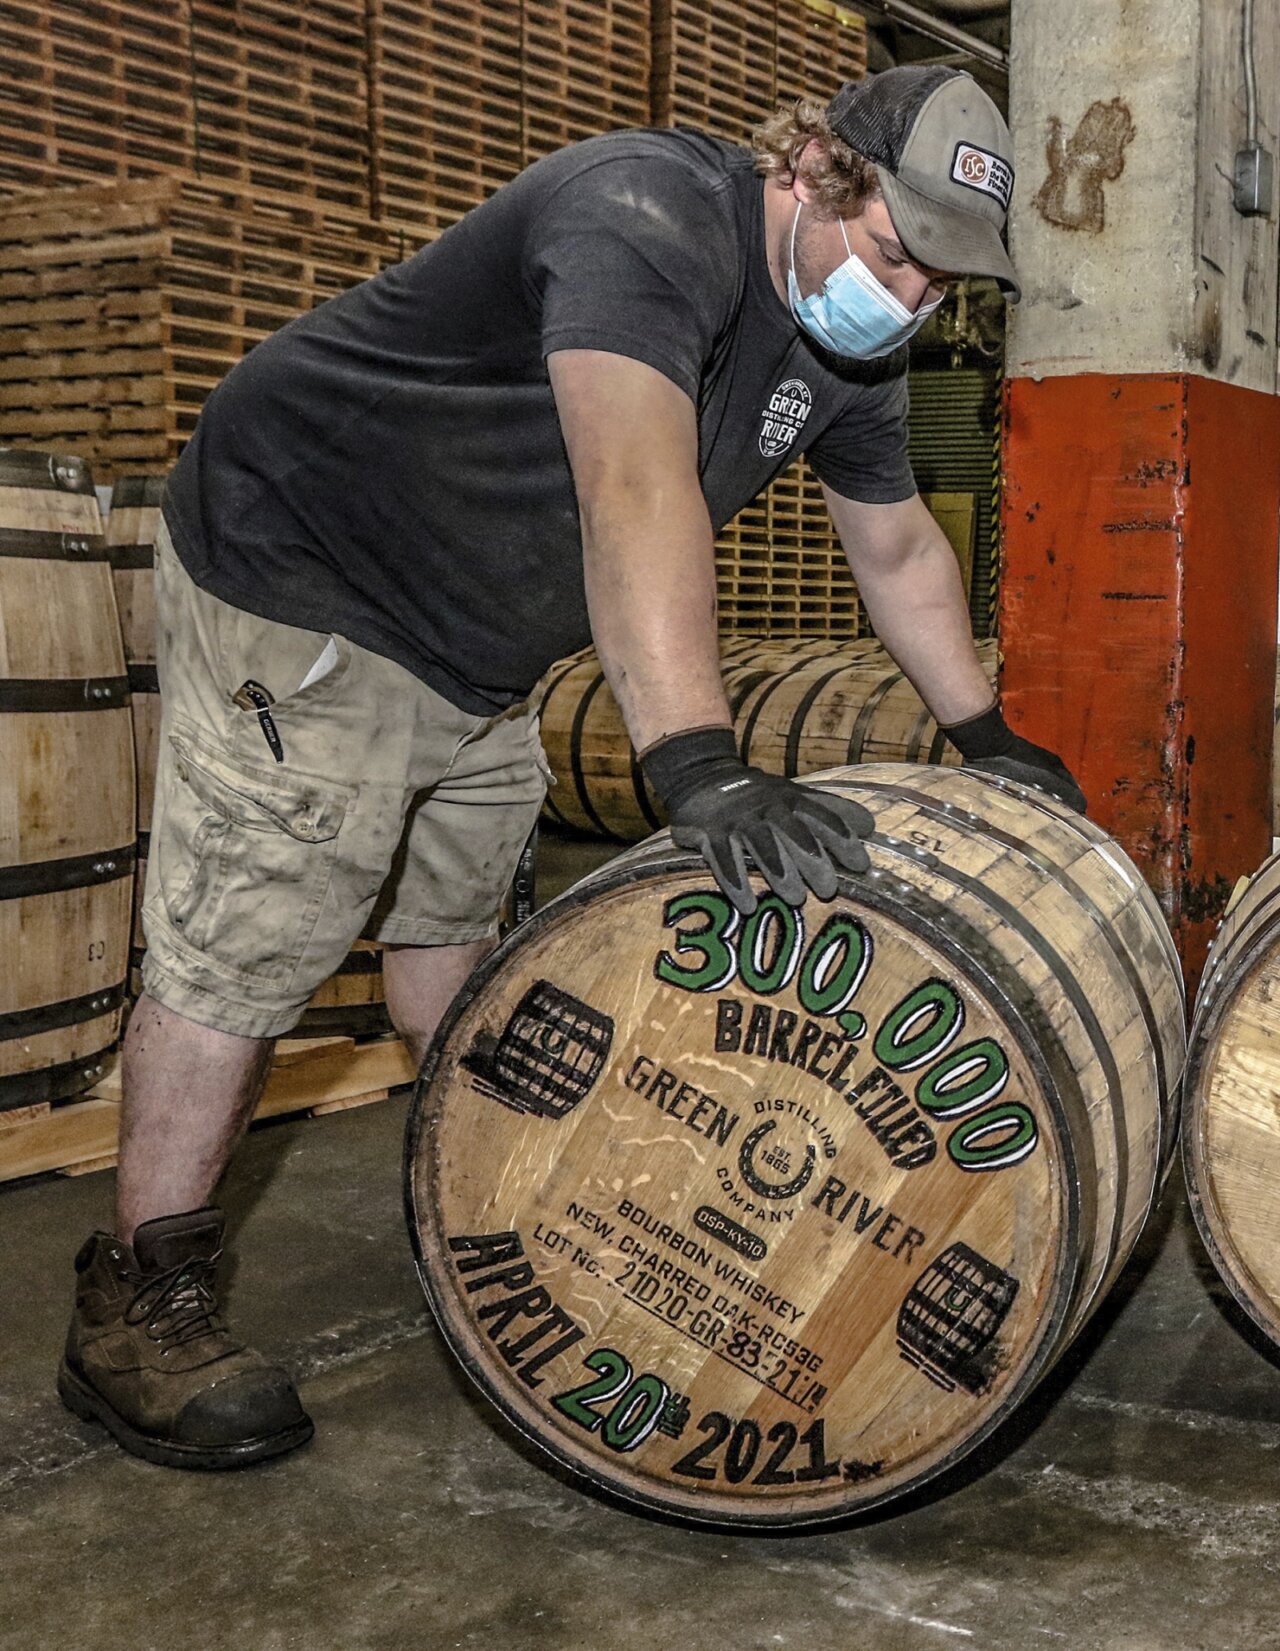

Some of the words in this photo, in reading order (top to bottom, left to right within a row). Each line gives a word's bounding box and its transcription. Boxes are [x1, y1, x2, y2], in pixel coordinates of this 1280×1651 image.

[654, 888, 1038, 1172] 300,000
[714, 998, 860, 1094] BARREL
[842, 1064, 938, 1171] FILLED
[753, 1099, 837, 1160] DISTILLING
[624, 1055, 741, 1148] GREEN
[810, 1175, 926, 1267] RIVER
[716, 1166, 795, 1224] COMPANY
[760, 1150, 792, 1175] 1865
[772, 1145, 792, 1163] EST.
[532, 1222, 573, 1254] LOT
[566, 1201, 616, 1245] NEW,
[617, 1235, 712, 1302] CHARRED
[616, 1199, 713, 1268] BOURBON
[713, 1259, 806, 1325] WHISKEY
[448, 1230, 586, 1390] APRIL
[671, 1410, 841, 1486] 2021
